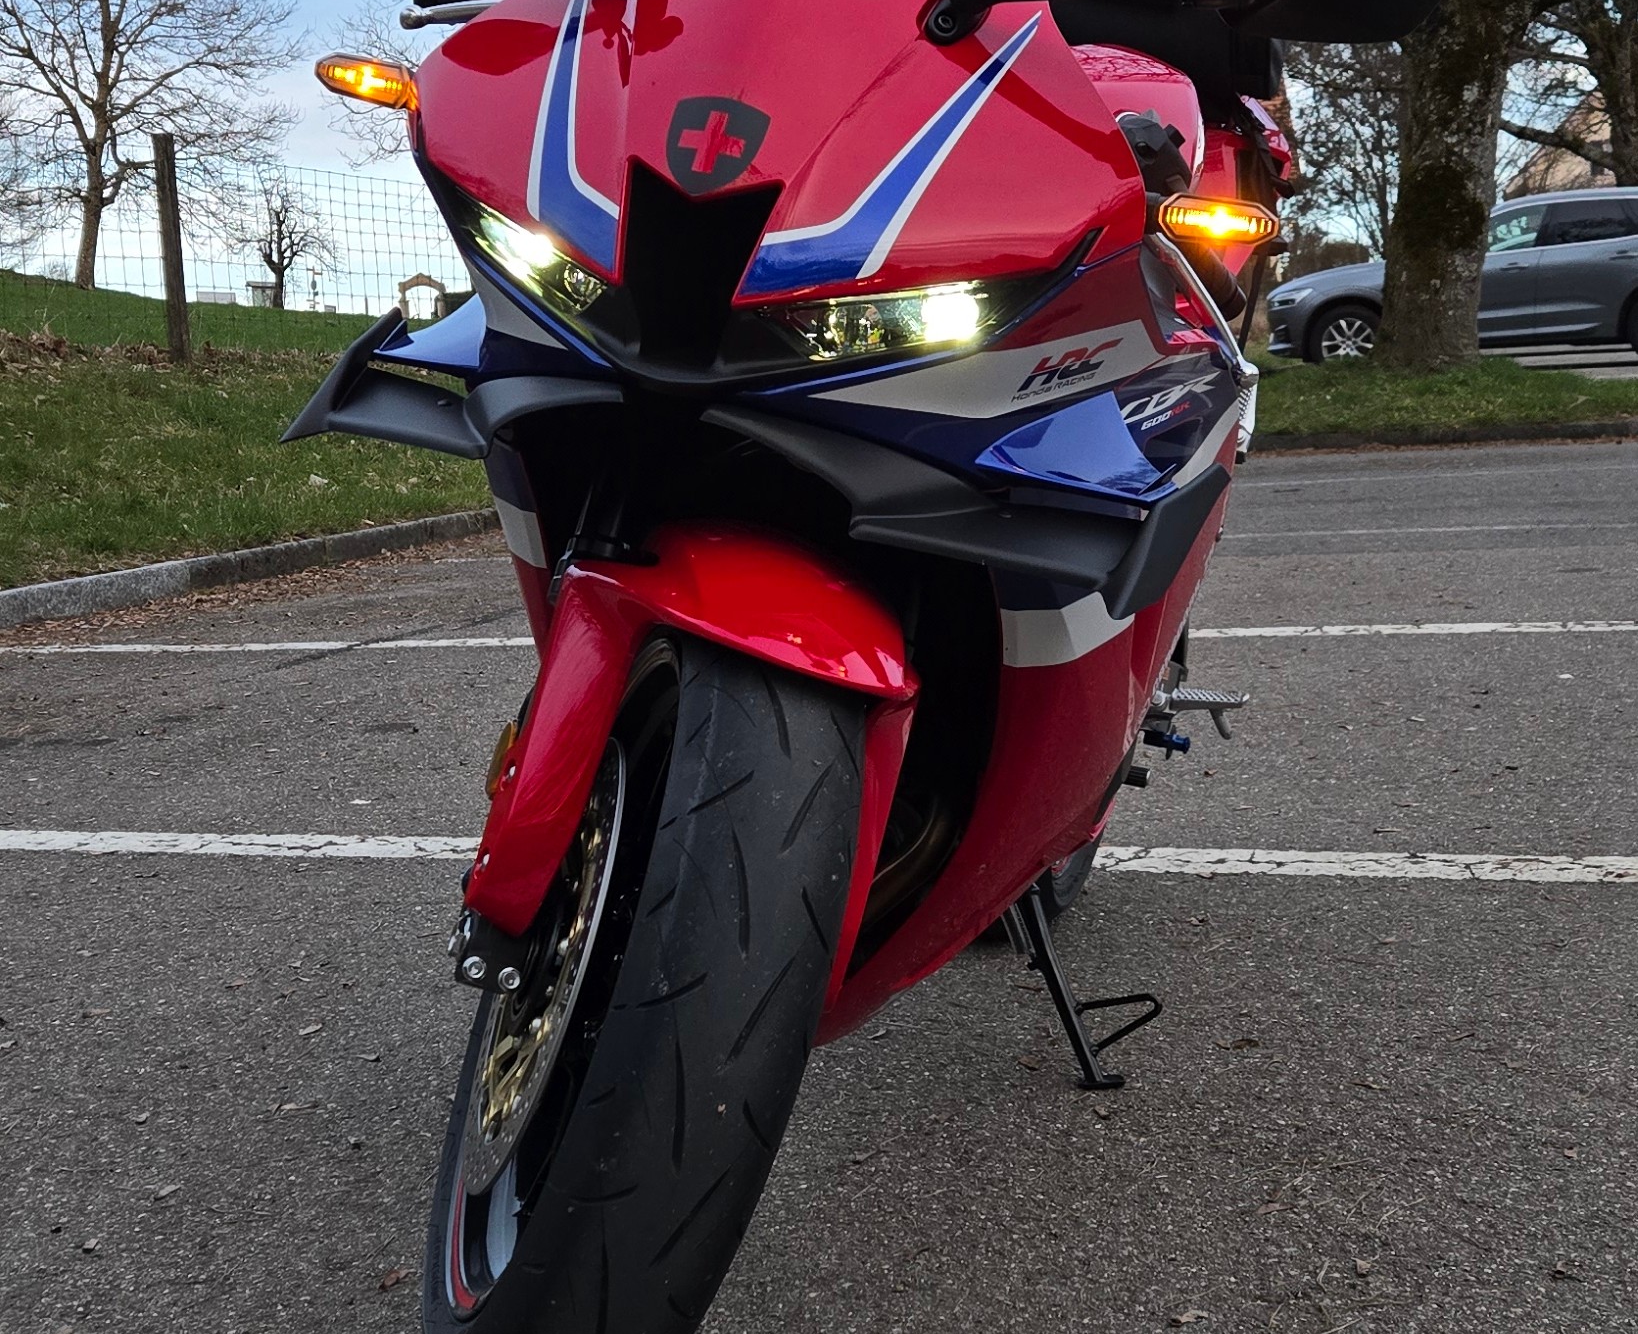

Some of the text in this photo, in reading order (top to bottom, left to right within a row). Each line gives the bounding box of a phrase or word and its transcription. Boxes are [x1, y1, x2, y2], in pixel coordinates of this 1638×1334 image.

[1010, 371, 1097, 403] Honda RACING
[1016, 337, 1124, 393] HRC
[1119, 370, 1221, 425] CBR
